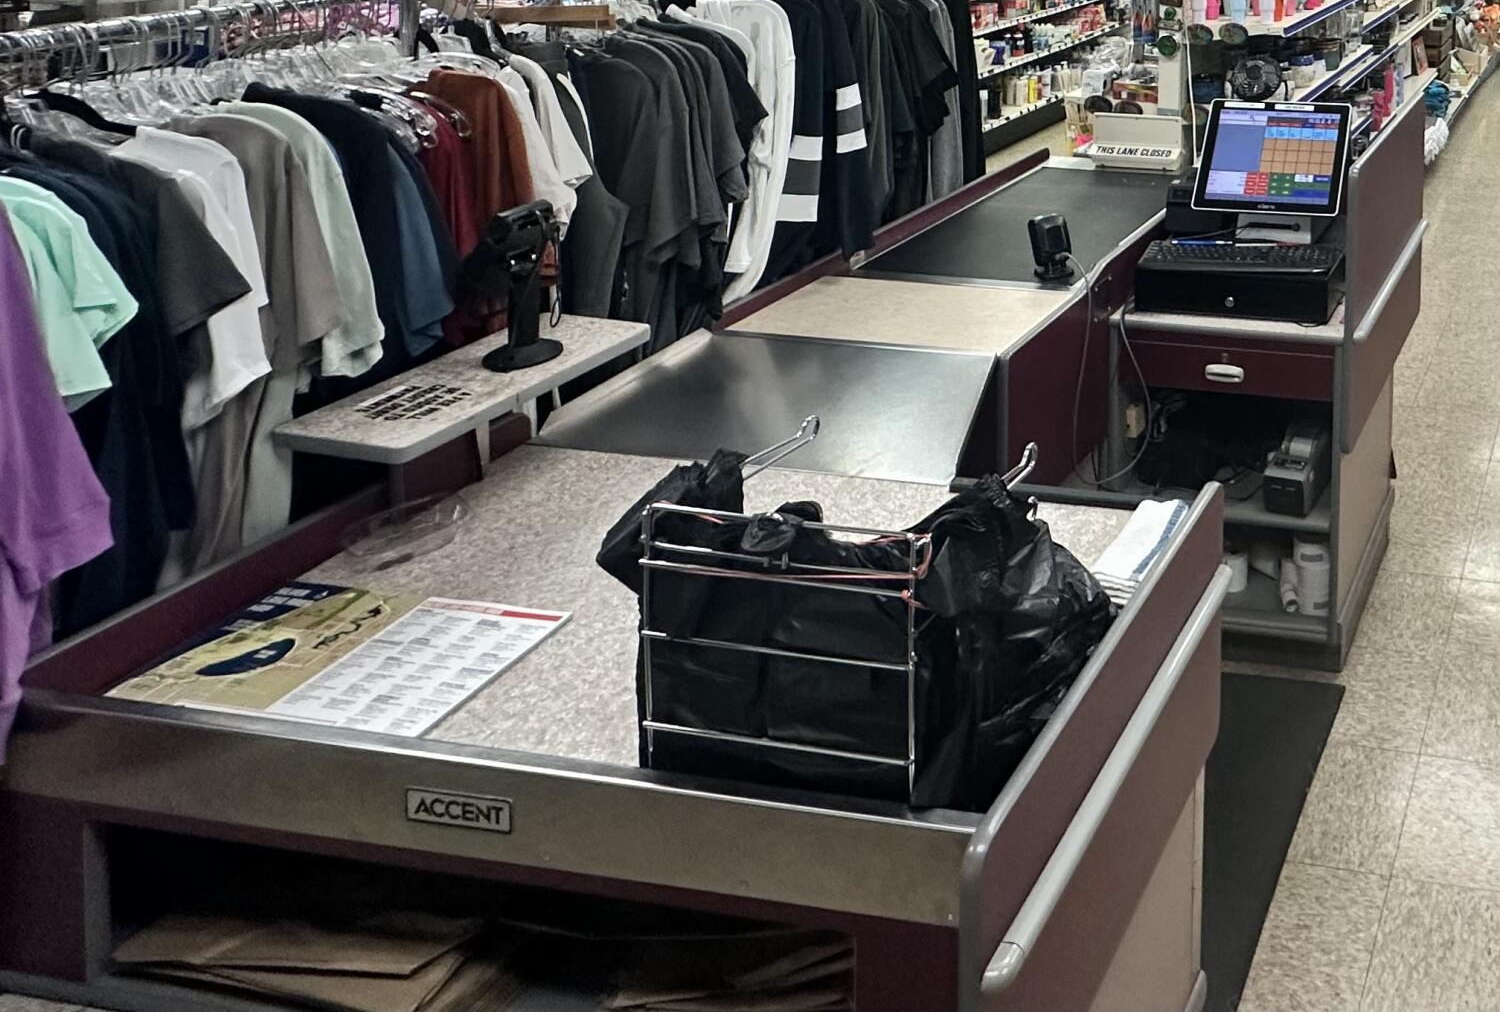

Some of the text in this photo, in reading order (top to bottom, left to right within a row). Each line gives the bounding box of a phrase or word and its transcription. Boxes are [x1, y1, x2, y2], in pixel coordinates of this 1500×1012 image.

[1096, 145, 1172, 158] THIS LANE CLOSED
[414, 796, 504, 825] ACCENT
